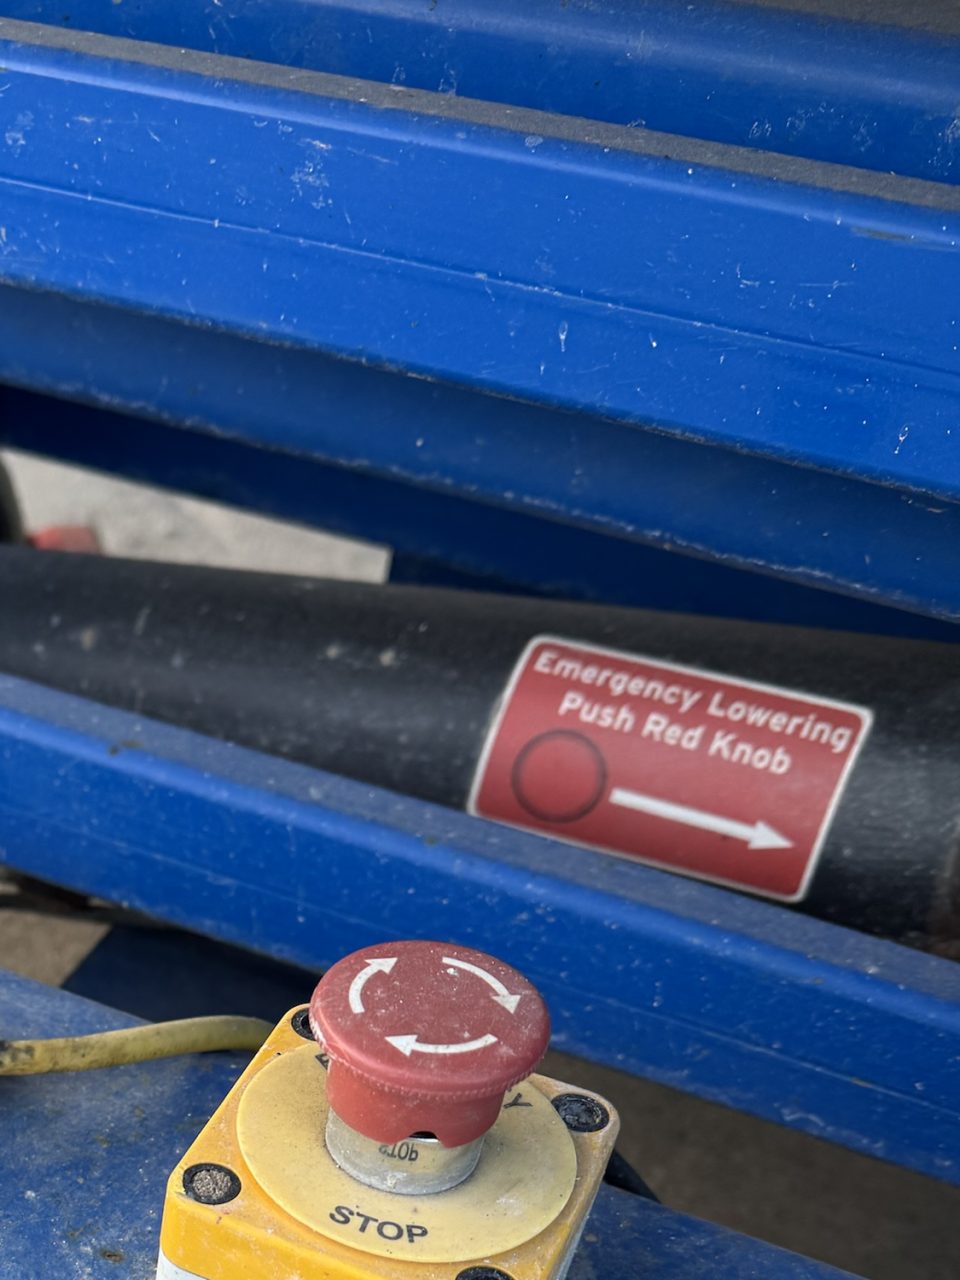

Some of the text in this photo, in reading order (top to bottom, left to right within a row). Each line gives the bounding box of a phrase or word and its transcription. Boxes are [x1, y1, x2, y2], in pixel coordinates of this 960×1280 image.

[534, 650, 853, 752] Emergency Lowering
[558, 692, 792, 775] Push Red Knob
[329, 1206, 428, 1243] STOP
